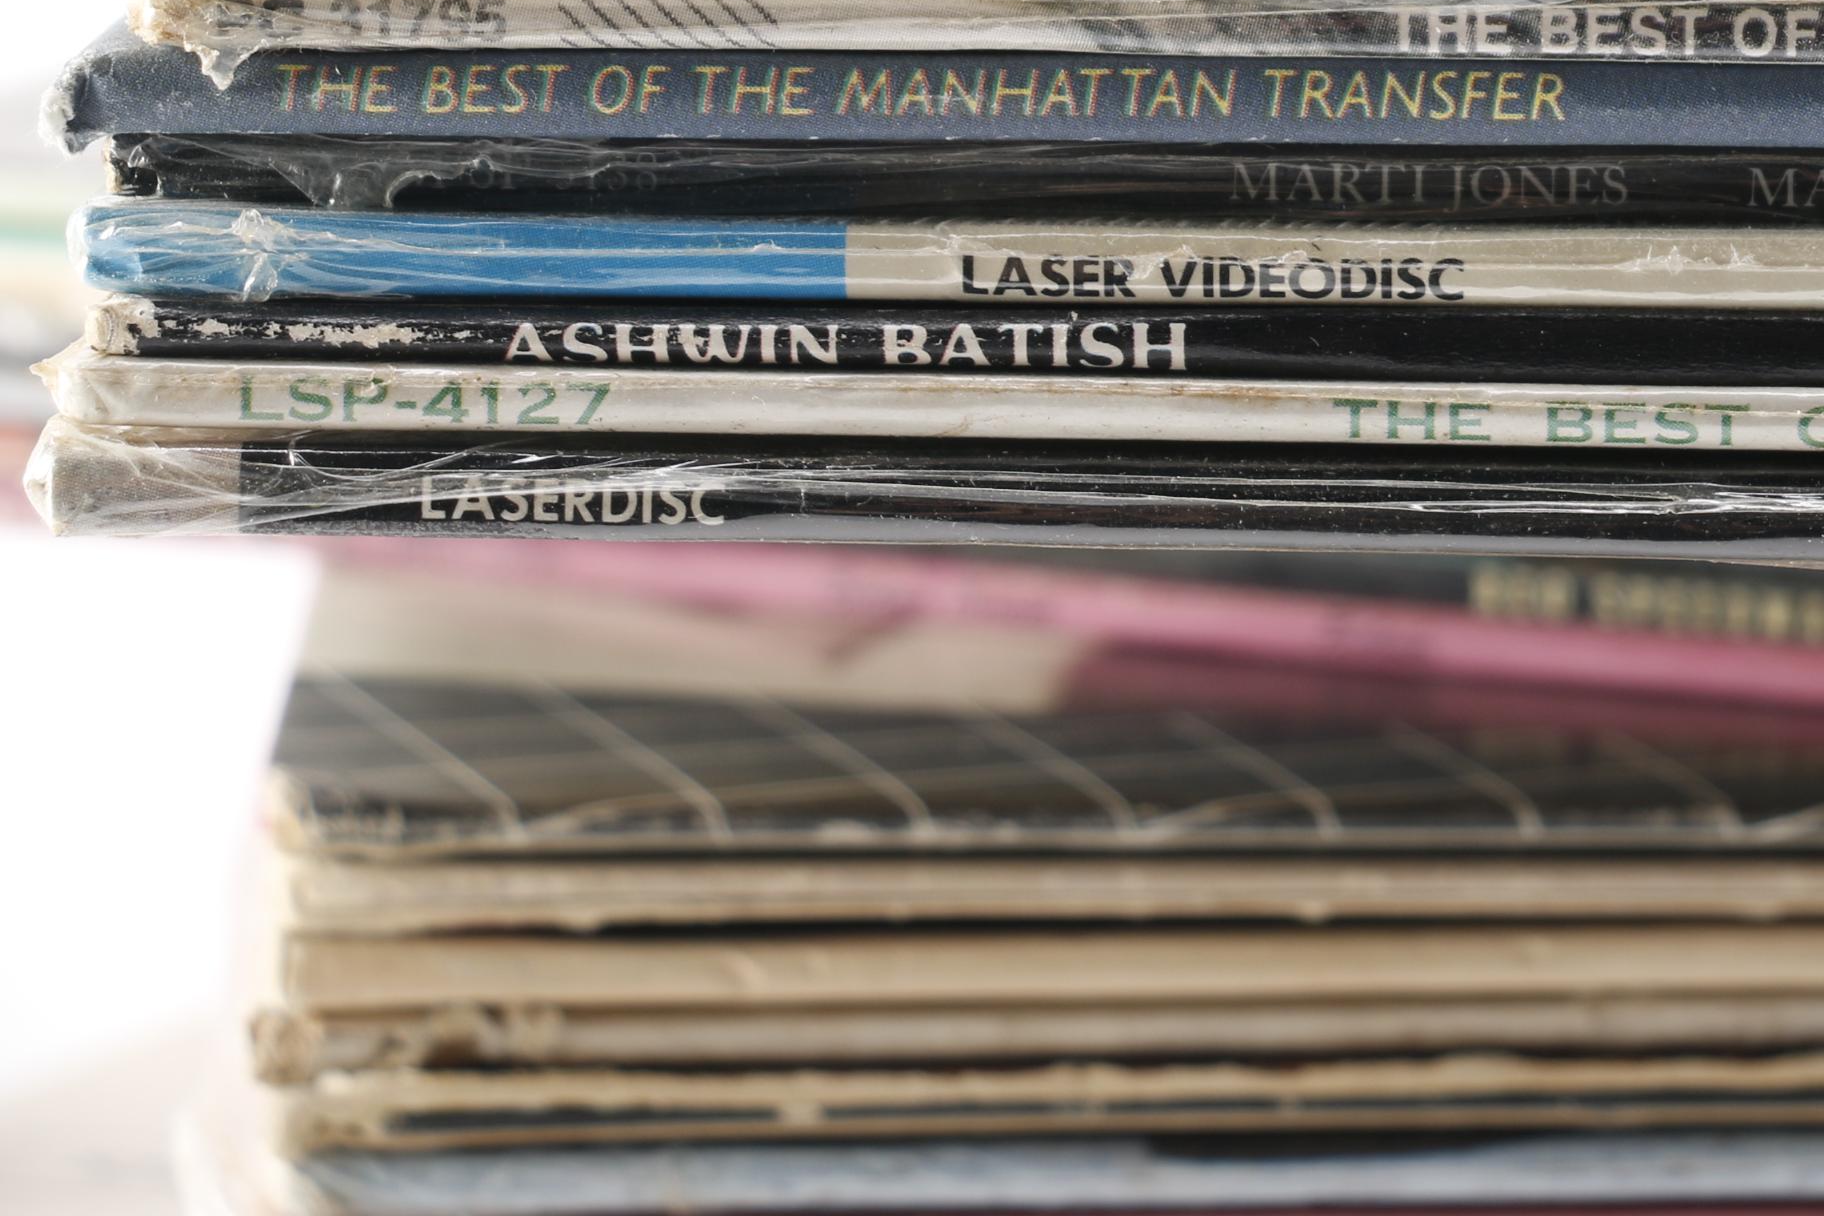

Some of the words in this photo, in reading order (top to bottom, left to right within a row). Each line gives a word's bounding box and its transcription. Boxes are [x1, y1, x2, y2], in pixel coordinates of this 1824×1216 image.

[1398, 7, 1509, 55] THE
[1540, 8, 1706, 57] BEST
[1732, 9, 1820, 58] OF
[276, 63, 398, 114] THE
[423, 64, 571, 115] BEST
[590, 64, 667, 115] OF
[695, 65, 816, 116] THE
[836, 67, 1238, 118] MANHATTAN
[1264, 69, 1567, 122] TRANSFER
[1228, 162, 1425, 204] MARTI
[1452, 164, 1629, 212] JONES
[961, 255, 1137, 298] LASER
[1162, 257, 1465, 302] VIDEODISC
[505, 322, 839, 366] ASHWIN
[883, 322, 1189, 371] BATISH
[239, 376, 611, 426] LSP-4127
[1331, 398, 1492, 443] THE
[1546, 400, 1752, 446] BEST
[420, 476, 726, 526] LASERDISC
